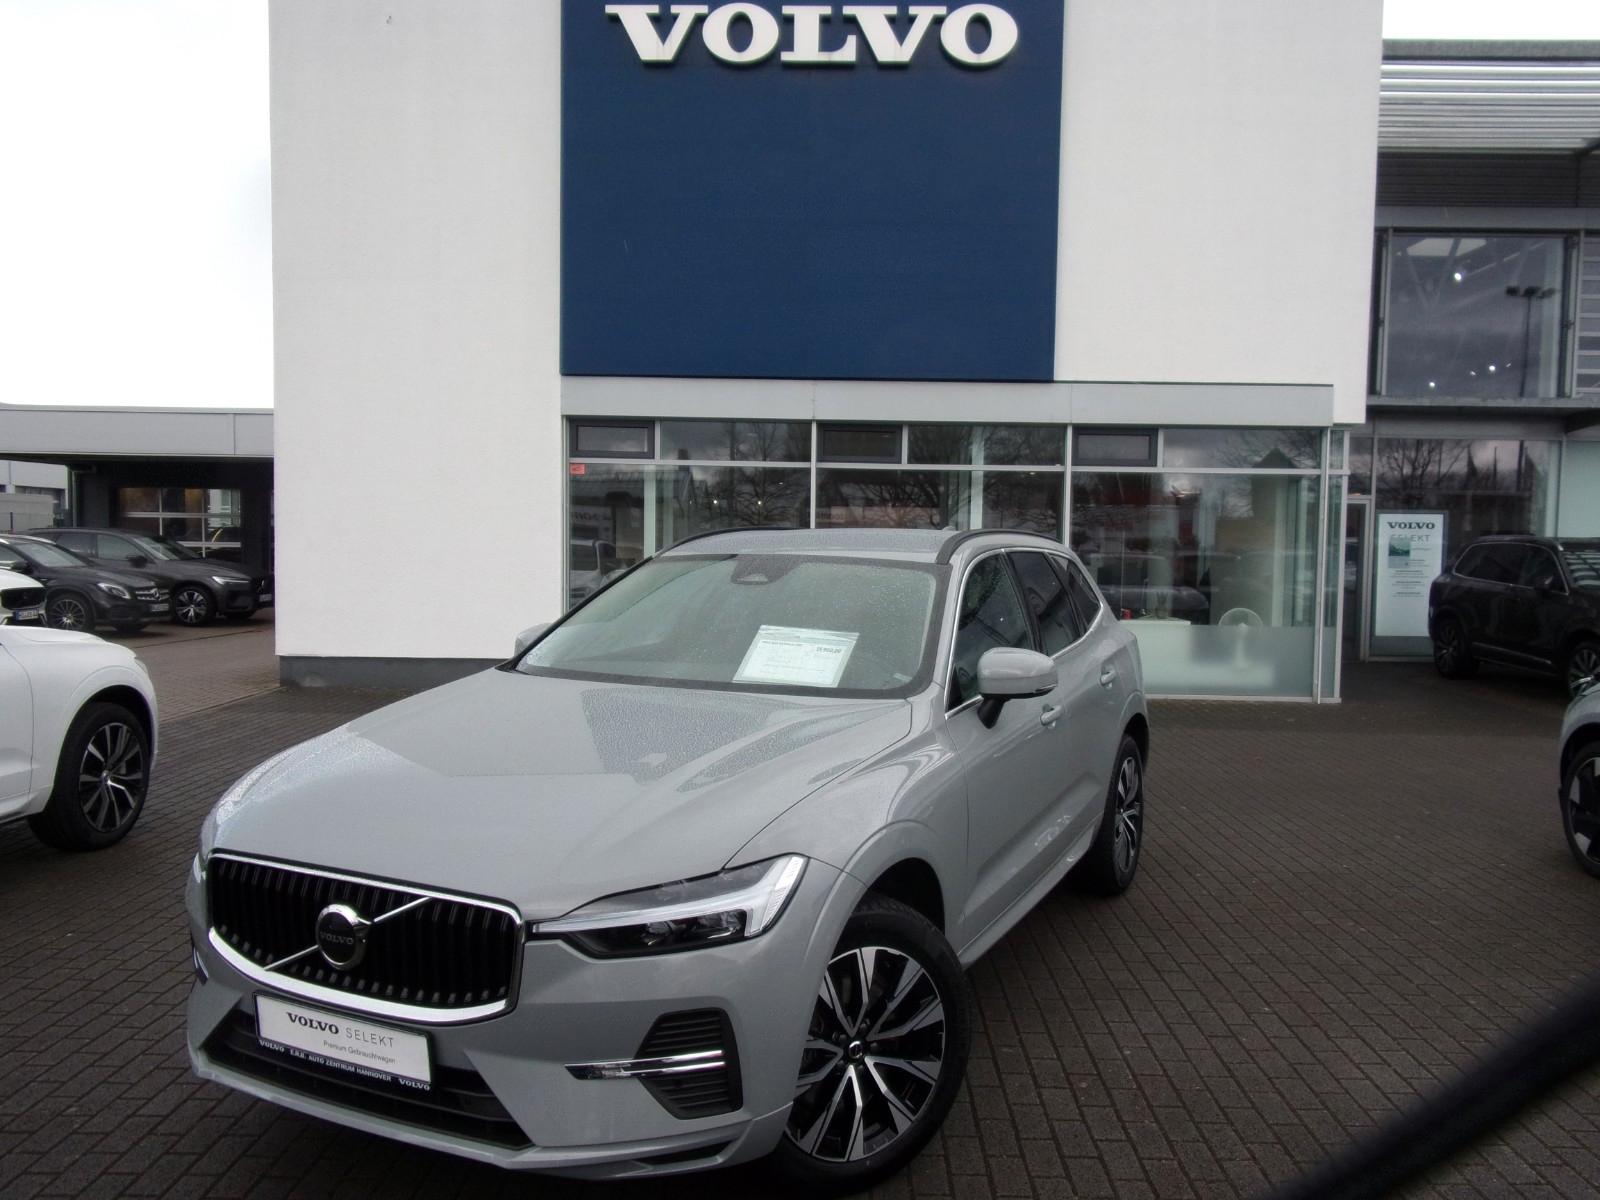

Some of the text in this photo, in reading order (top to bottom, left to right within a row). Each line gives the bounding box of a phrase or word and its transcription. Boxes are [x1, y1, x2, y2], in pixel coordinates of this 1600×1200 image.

[605, 2, 1019, 64] VOLVO
[1387, 521, 1436, 530] VOLVO
[320, 930, 354, 945] VOLVO
[286, 1012, 394, 1048] VOLVO SELEKT
[259, 1040, 286, 1053] VOLVO
[308, 1054, 325, 1066] AUTO
[325, 1058, 356, 1073] ZENTRUM
[356, 1066, 392, 1082] HANNOVER
[399, 1077, 431, 1091] VOLVO
